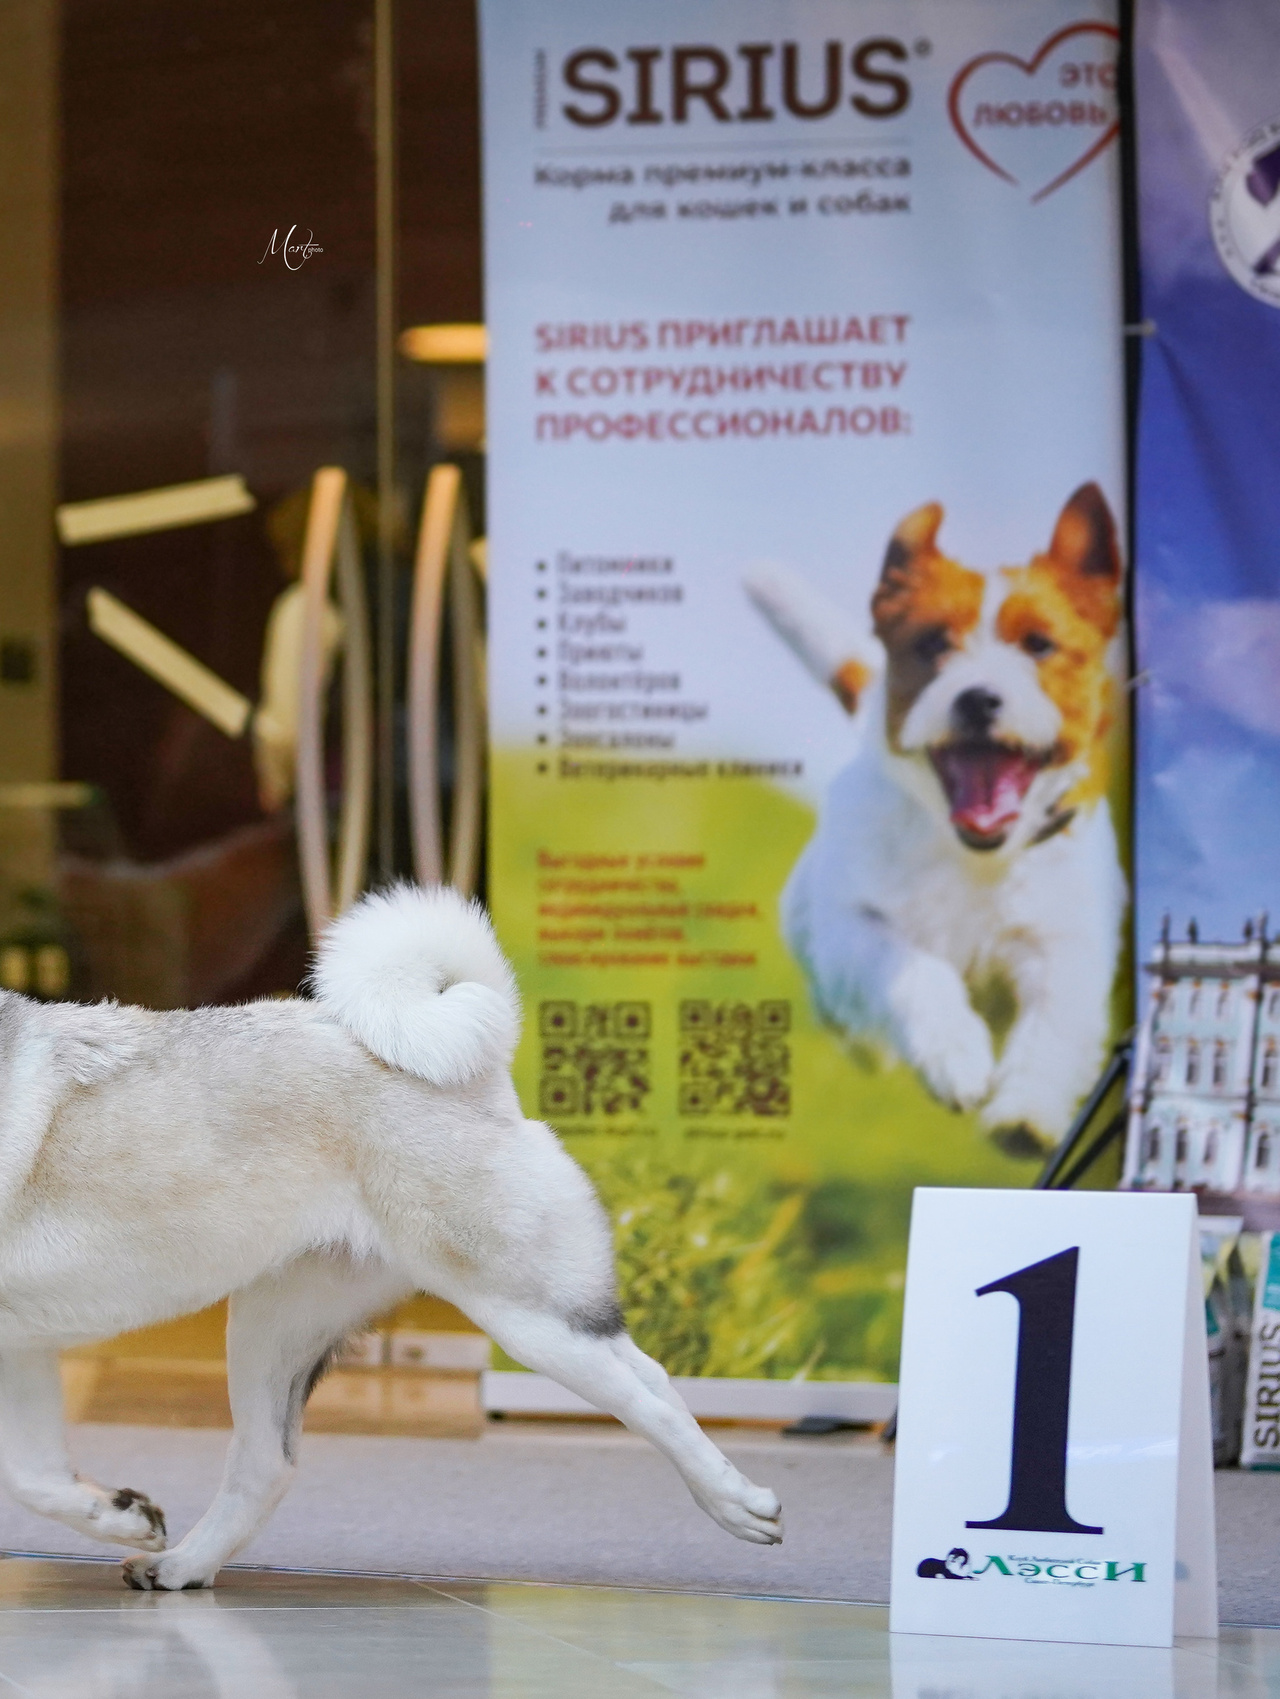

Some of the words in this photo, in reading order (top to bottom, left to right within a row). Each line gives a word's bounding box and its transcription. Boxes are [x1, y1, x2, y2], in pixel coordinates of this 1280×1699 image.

[562, 37, 912, 128] SIRIUS
[974, 101, 1108, 129] ЛЮБОВЬ
[535, 163, 634, 190] Корма
[609, 201, 666, 225] для
[677, 199, 778, 219] кошек
[789, 198, 808, 215] и
[817, 187, 911, 214] собак
[535, 321, 649, 352] SIRIUS
[657, 314, 911, 347] ПРИГЛАШАЕТ
[535, 369, 556, 397] К
[566, 361, 908, 398] СОТРУДНИЧЕСТВУ
[535, 406, 912, 441] ПРОФЕССИОНАЛОВ:
[965, 1246, 1104, 1534] 1
[1254, 1324, 1280, 1448] SIRIUS
